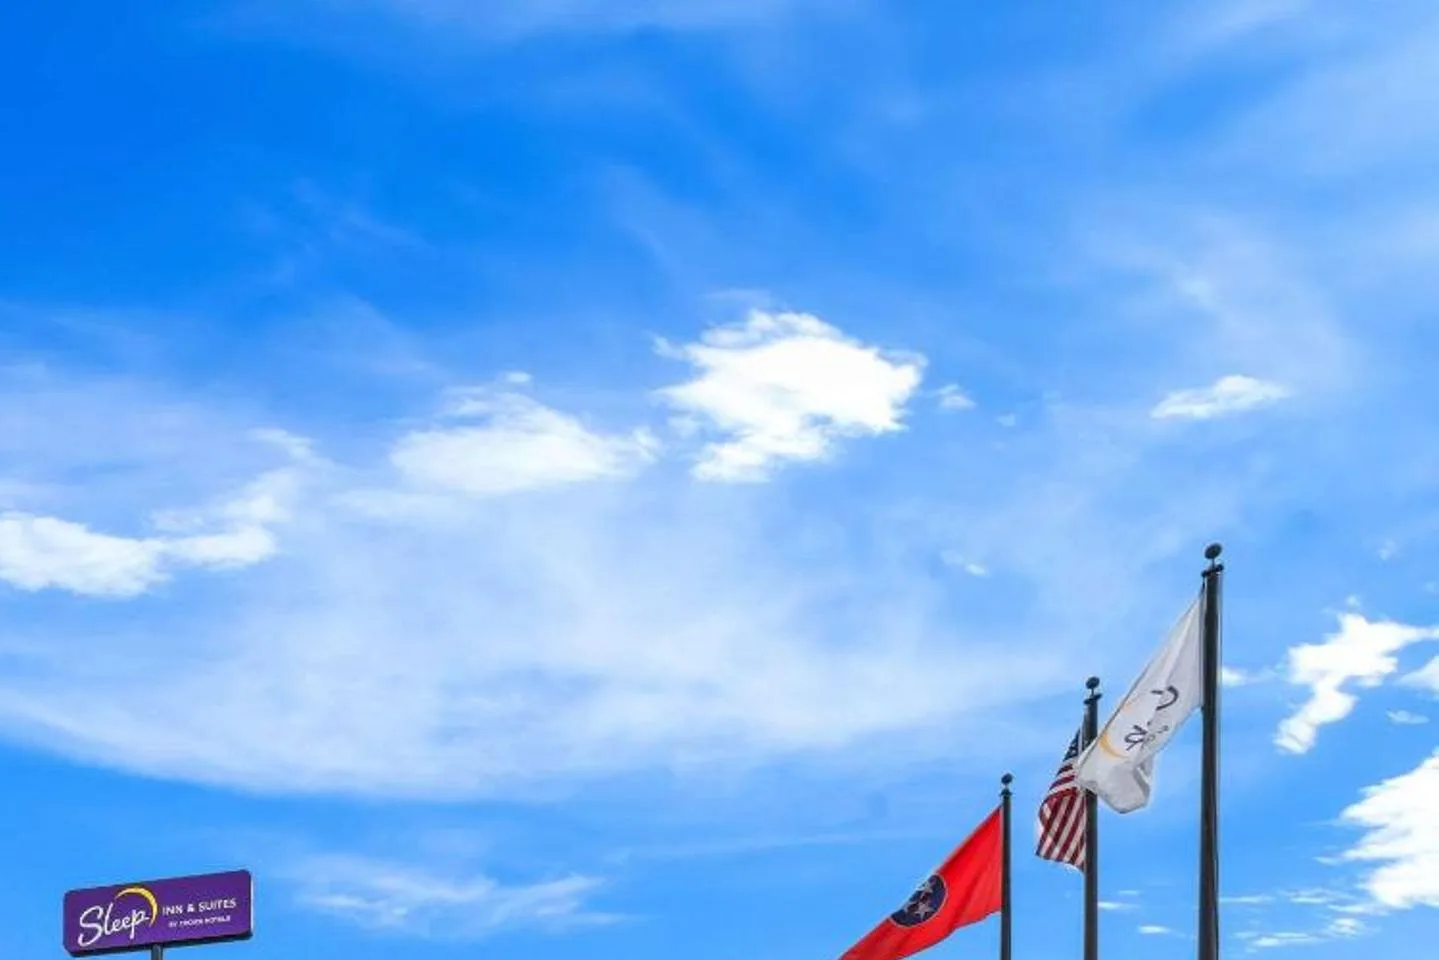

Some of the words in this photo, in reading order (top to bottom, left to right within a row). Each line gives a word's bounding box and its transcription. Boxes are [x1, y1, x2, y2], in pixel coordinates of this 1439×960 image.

[78, 902, 150, 947] Sleep
[162, 905, 183, 916] INN
[187, 903, 195, 913] &
[198, 898, 237, 913] SUITES
